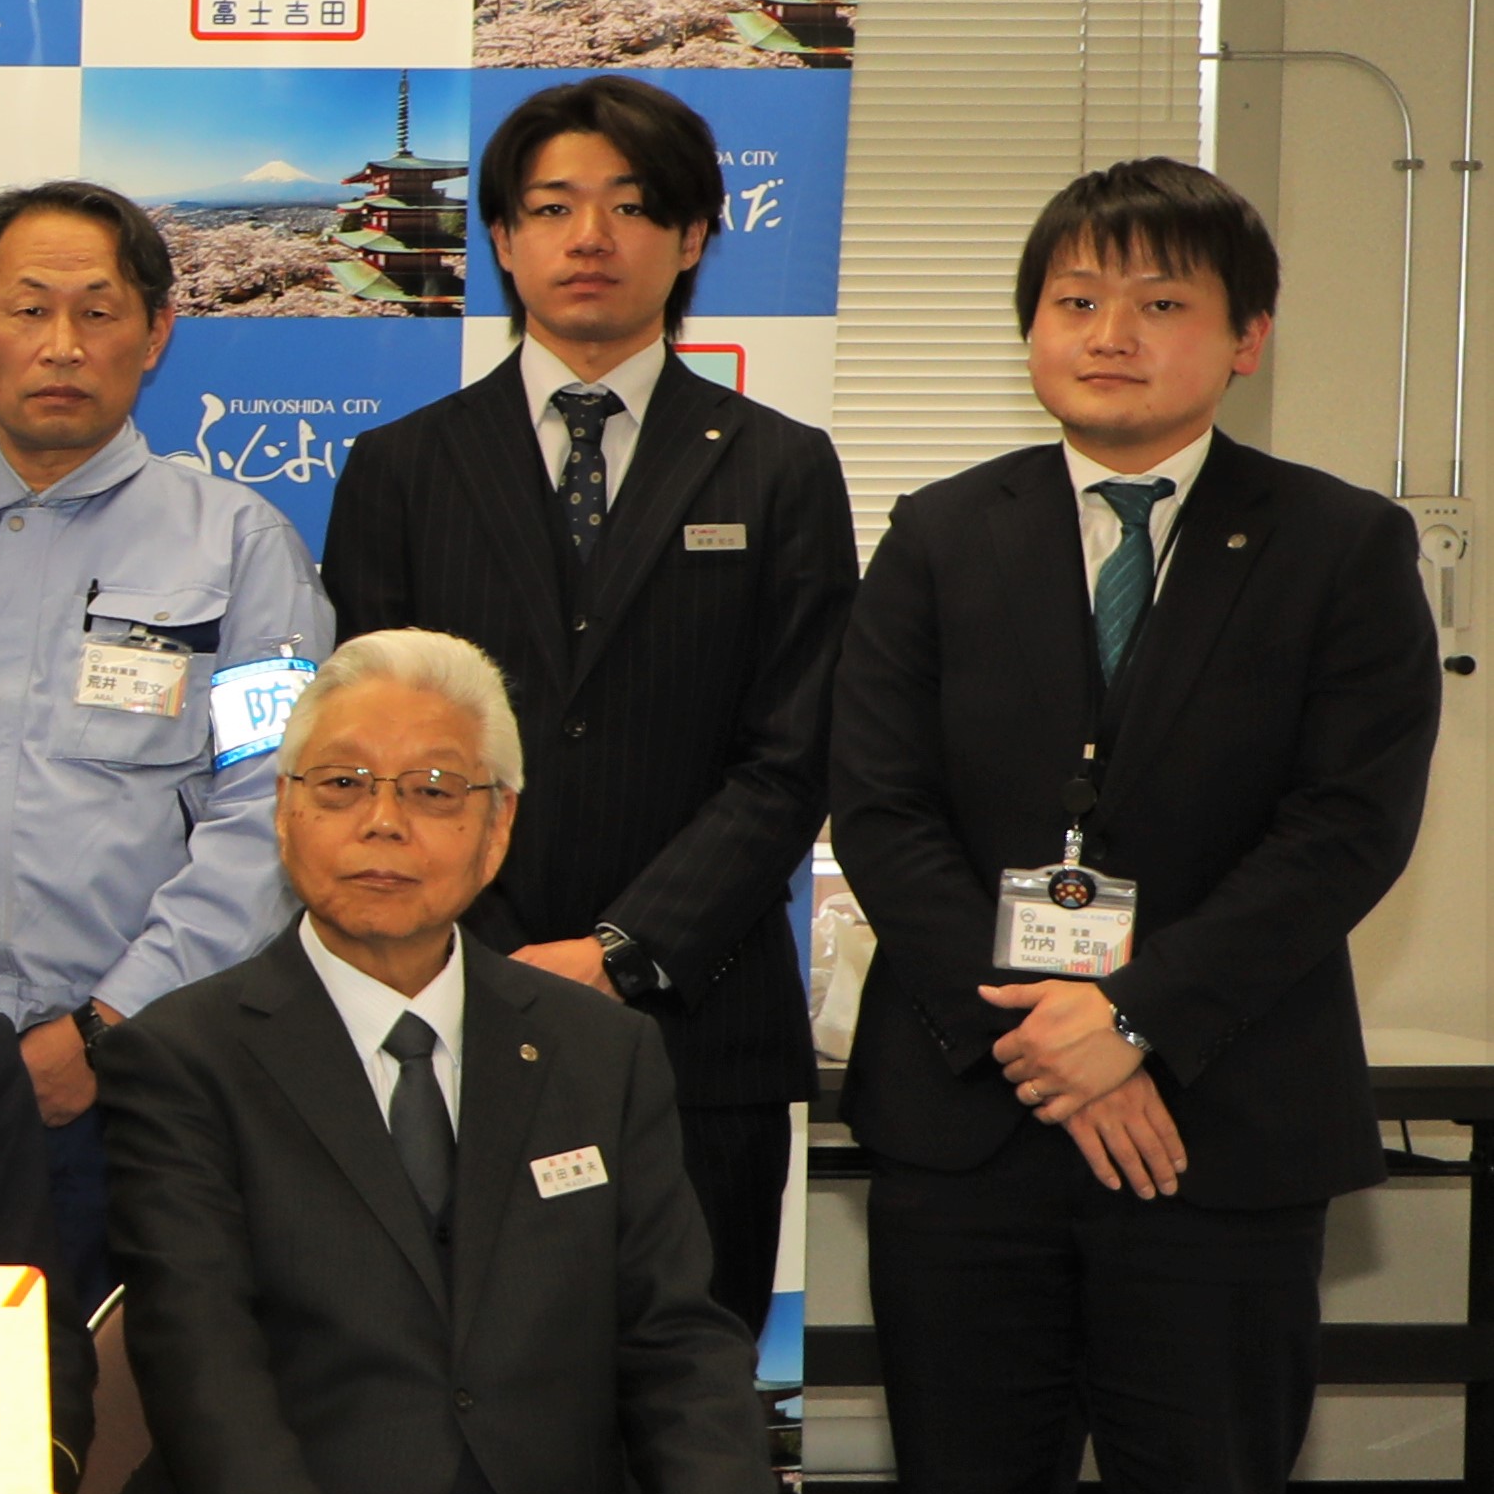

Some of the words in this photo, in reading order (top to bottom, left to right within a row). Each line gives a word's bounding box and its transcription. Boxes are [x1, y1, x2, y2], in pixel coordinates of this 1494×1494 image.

[740, 150, 778, 166] CITY
[229, 398, 336, 415] FUJIYOSHIDA
[342, 398, 382, 415] CITY
[1020, 934, 1057, 953] 竹内
